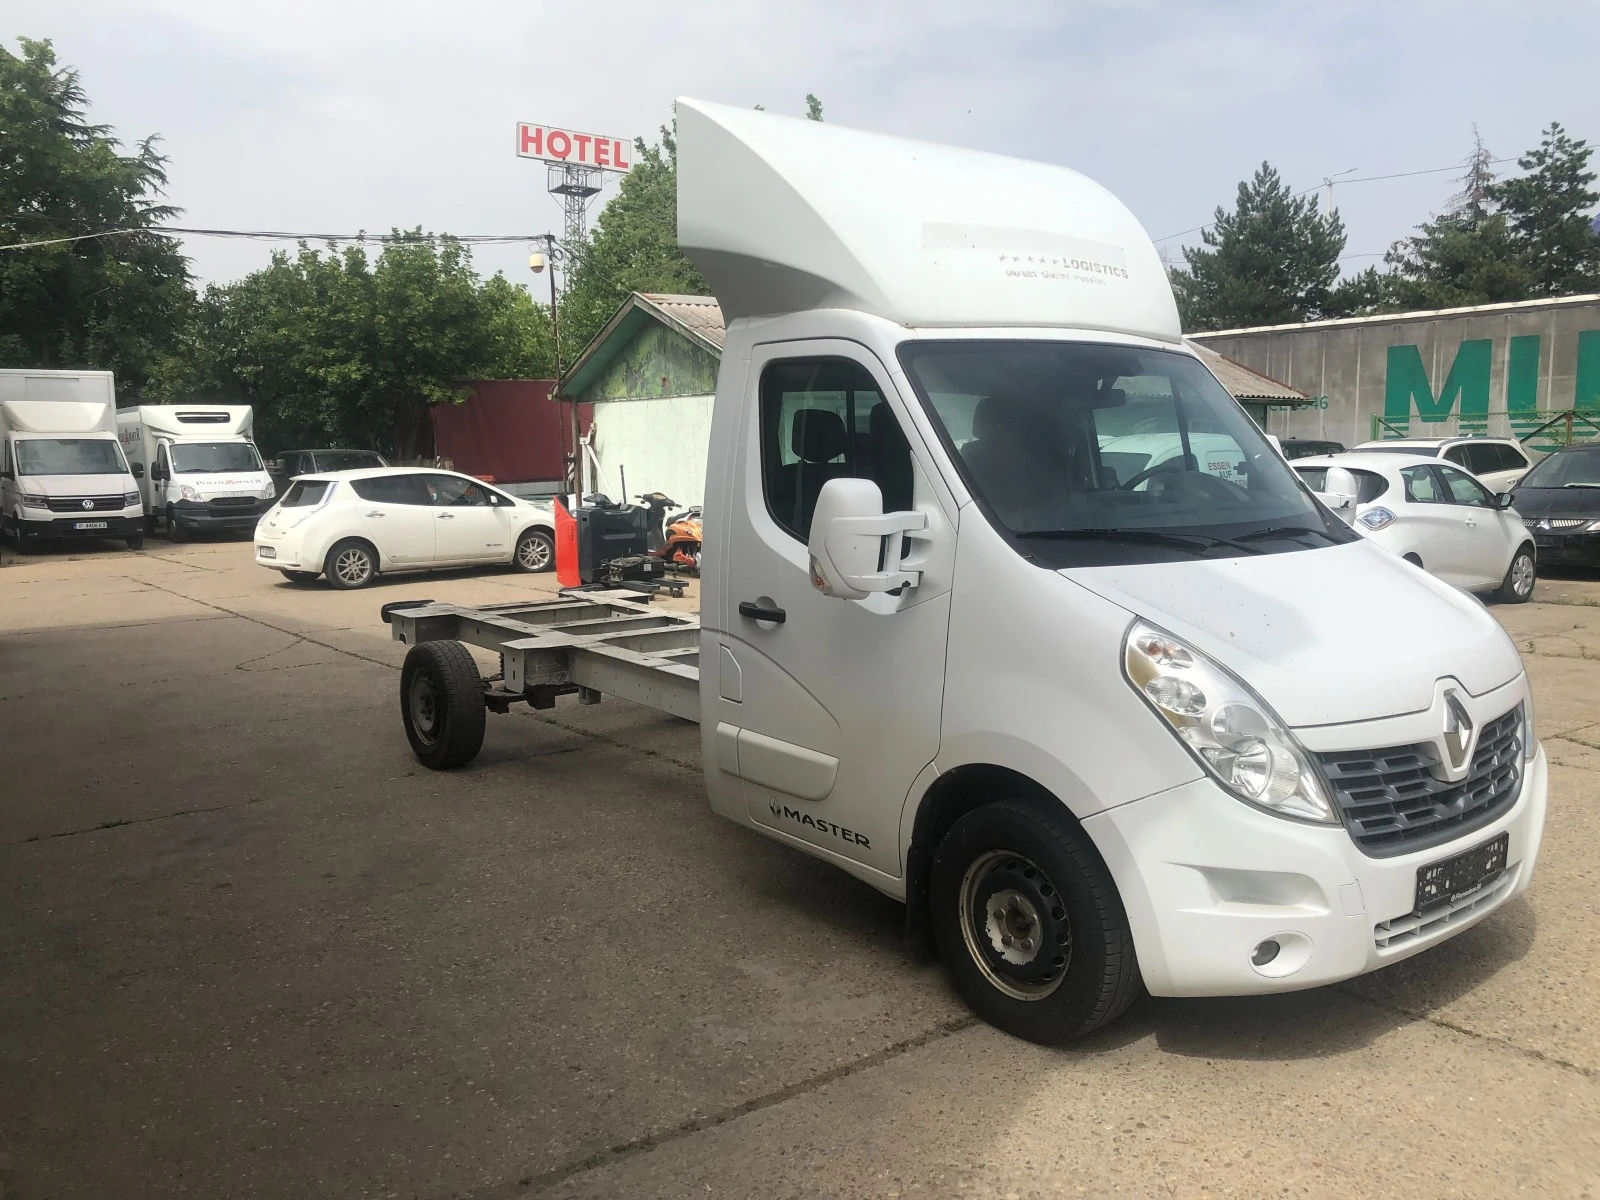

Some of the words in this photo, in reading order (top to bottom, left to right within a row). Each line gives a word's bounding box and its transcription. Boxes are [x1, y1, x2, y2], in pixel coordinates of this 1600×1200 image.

[521, 125, 629, 169] HOTEL
[1062, 257, 1129, 279] LOGISTICS
[1207, 461, 1232, 471] ESSEN
[1219, 470, 1233, 479] AUF
[783, 805, 872, 850] MASTER
